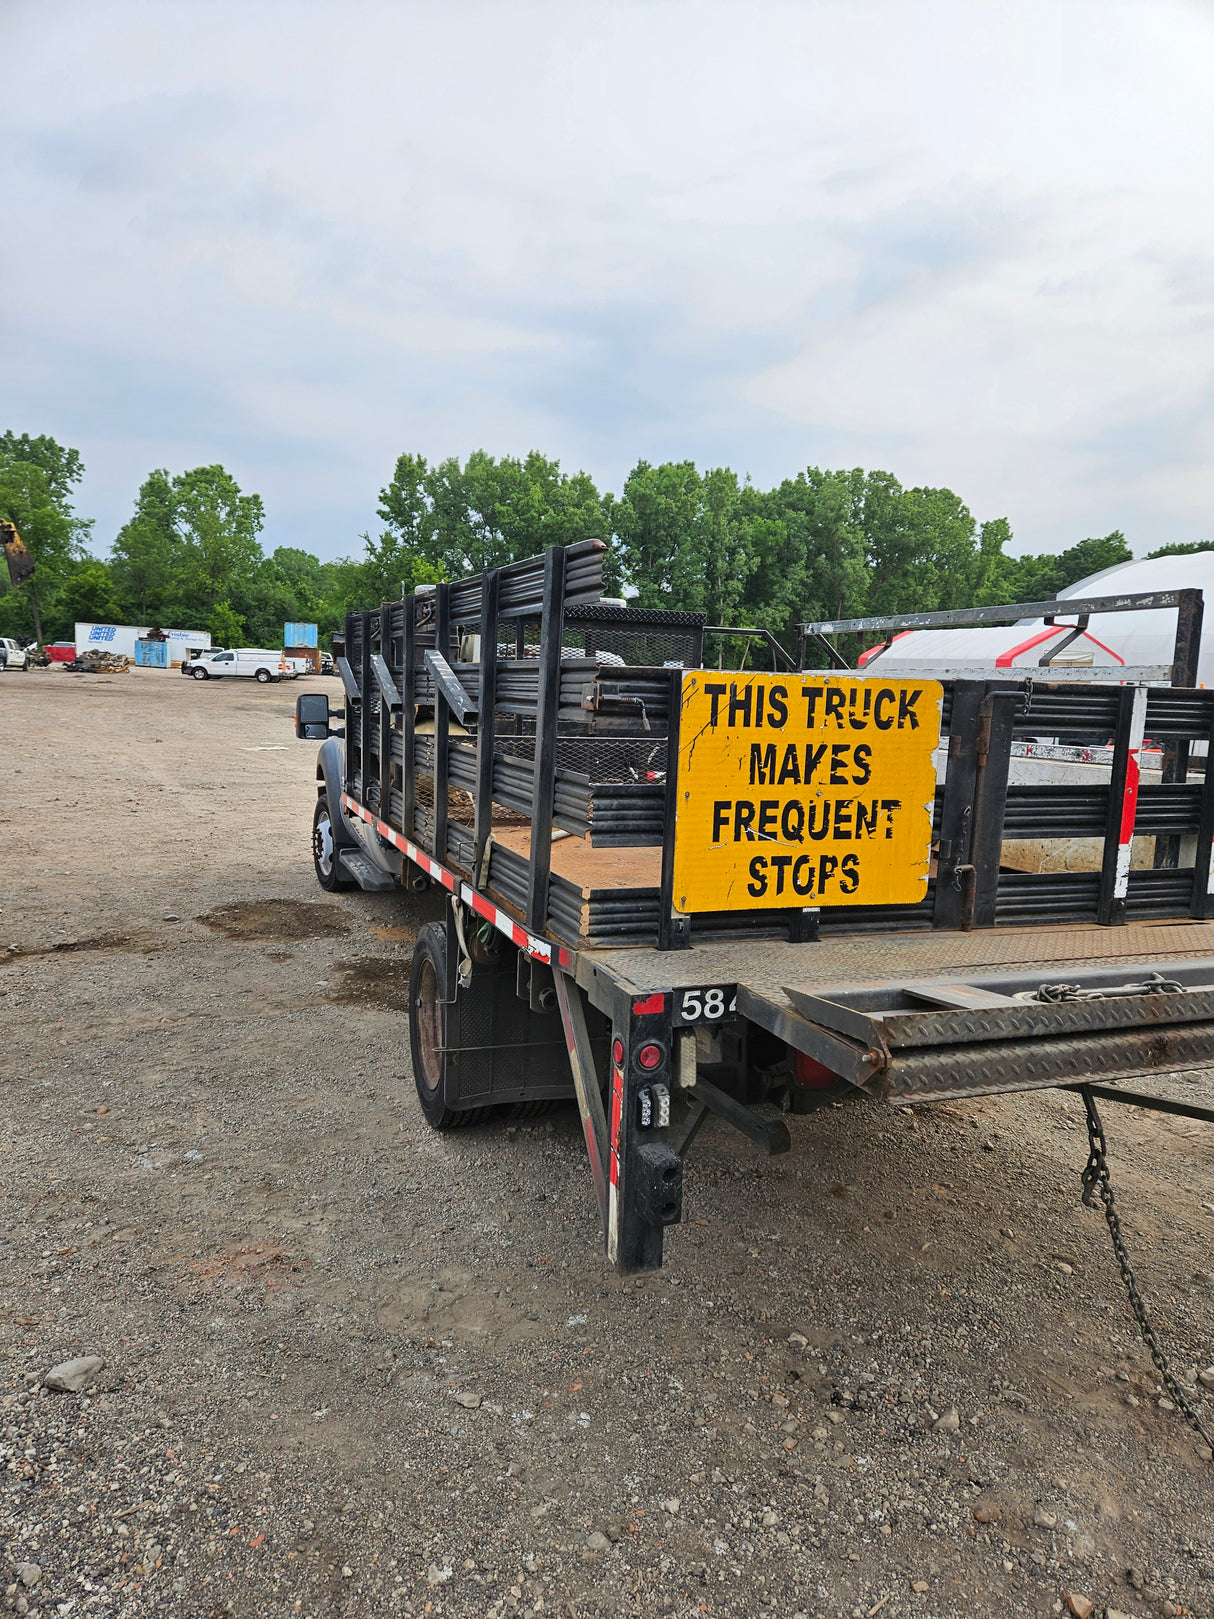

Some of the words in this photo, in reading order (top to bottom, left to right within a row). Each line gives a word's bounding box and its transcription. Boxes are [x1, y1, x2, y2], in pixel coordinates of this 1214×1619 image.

[704, 683, 789, 729] THIS
[801, 686, 923, 730] TRUCK
[748, 743, 873, 785] MAKES
[712, 799, 902, 845] FREQUENT
[747, 853, 860, 898] STOPS
